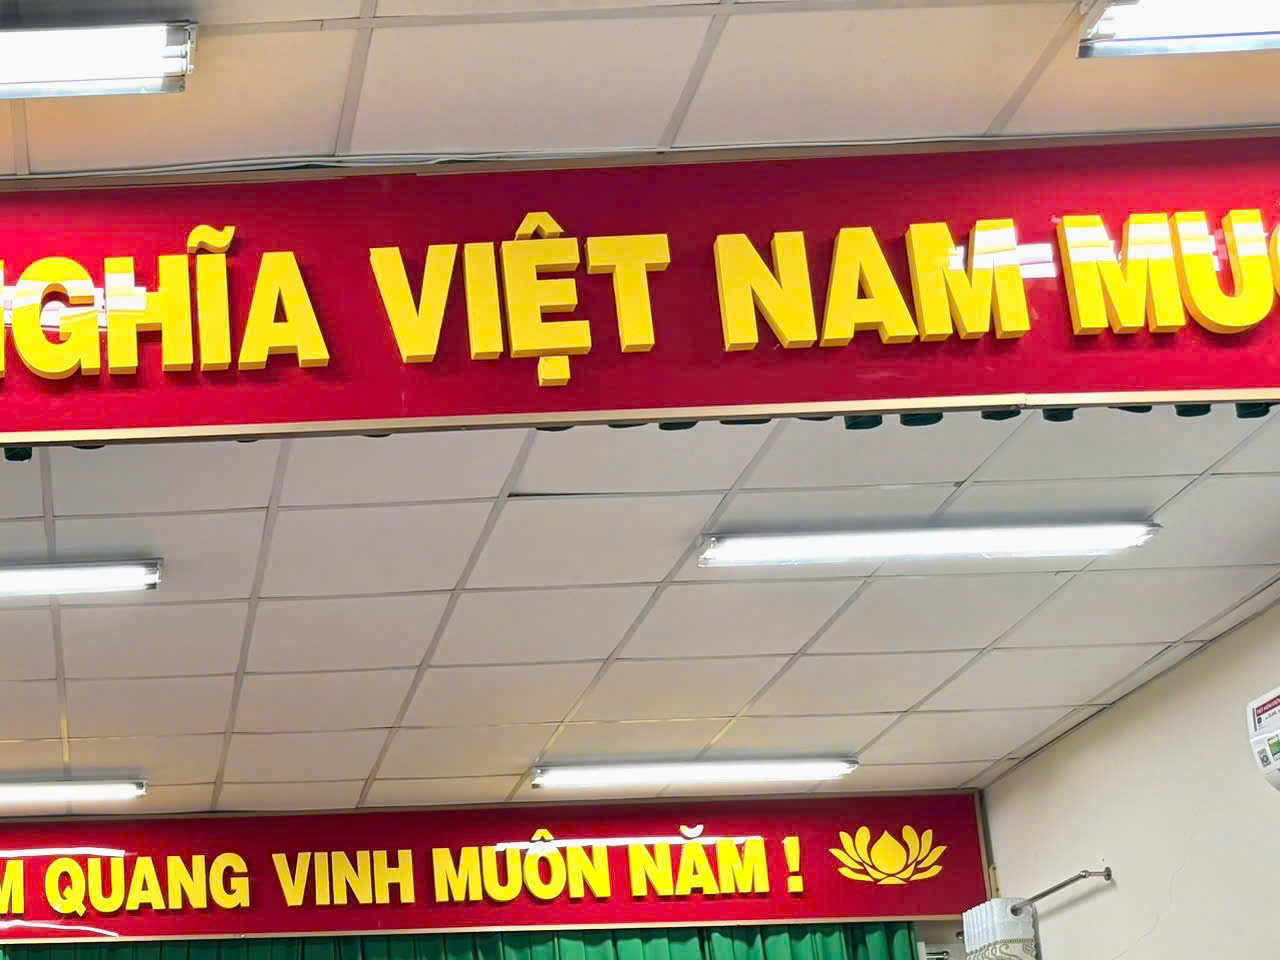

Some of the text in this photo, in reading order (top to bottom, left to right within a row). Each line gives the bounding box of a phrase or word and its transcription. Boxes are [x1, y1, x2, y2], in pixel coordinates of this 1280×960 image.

[370, 212, 670, 387] VIỆT
[714, 218, 1031, 351] NAM
[44, 853, 250, 917] QUANG
[272, 849, 415, 907] VINH
[433, 828, 612, 903] MUÔN
[630, 824, 770, 898] NĂM
